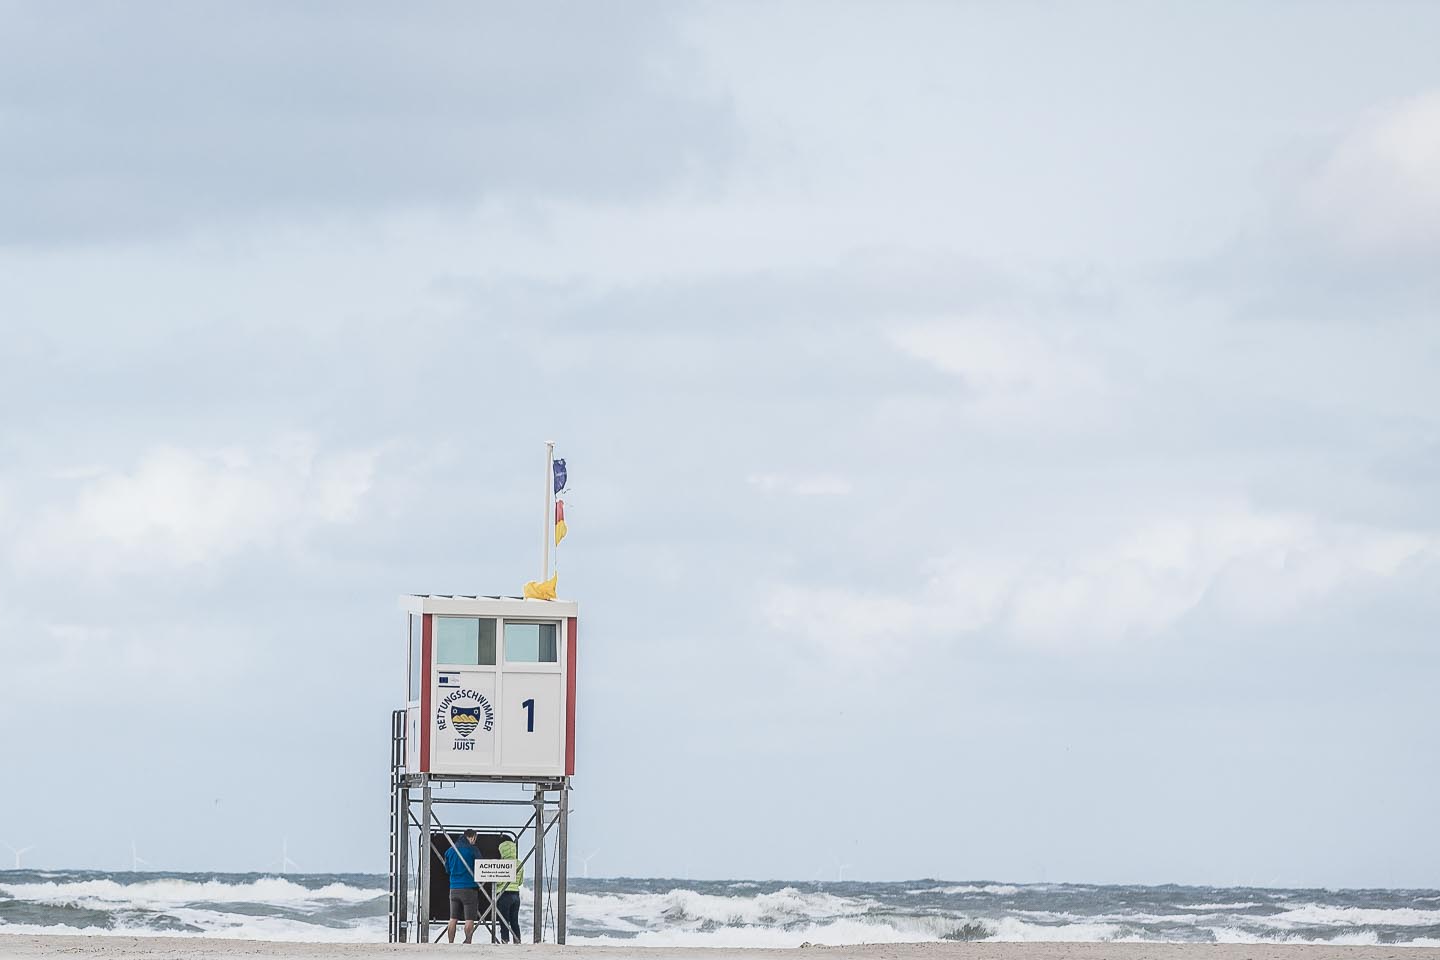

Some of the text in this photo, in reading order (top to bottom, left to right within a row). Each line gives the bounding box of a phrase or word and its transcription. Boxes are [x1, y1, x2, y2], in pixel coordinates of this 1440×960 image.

[437, 689, 494, 732] RETTUNGSSCHWIMMER
[522, 698, 535, 733] 1
[452, 741, 476, 751] JUIST
